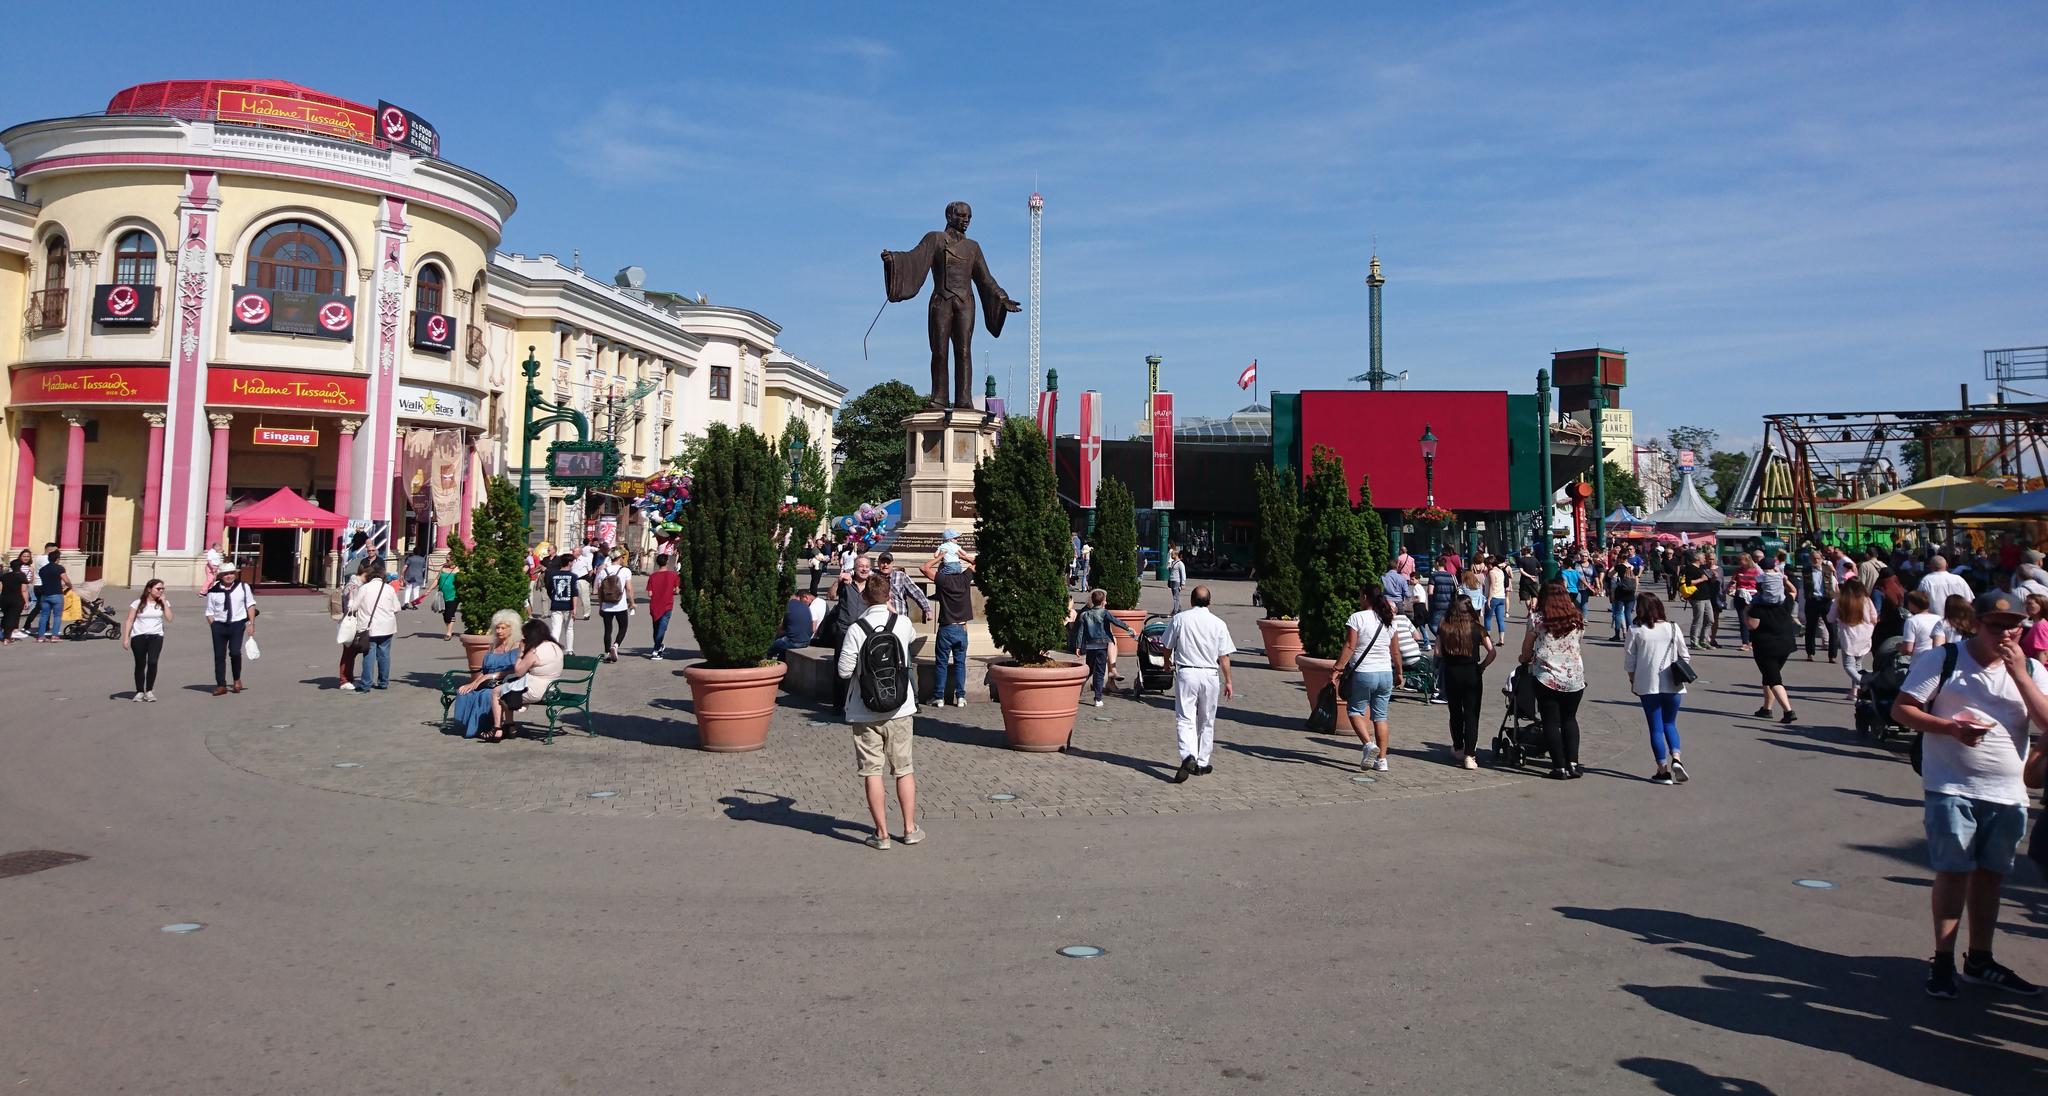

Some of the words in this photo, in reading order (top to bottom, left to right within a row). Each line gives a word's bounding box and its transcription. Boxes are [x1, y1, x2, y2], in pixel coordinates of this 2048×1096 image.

[241, 97, 301, 119] Madame
[298, 107, 358, 136] Tussauds
[418, 124, 432, 138] FOOD
[418, 133, 432, 145] FAST
[42, 374, 80, 392] Madame
[78, 373, 130, 396] Tussauds
[233, 377, 292, 395] Madame
[288, 382, 349, 406] Tussauds
[399, 398, 424, 410] Walk
[435, 403, 454, 415] Stars
[1604, 413, 1623, 422] BLUE
[1601, 424, 1628, 432] PLANET
[263, 431, 310, 443] Eingang
